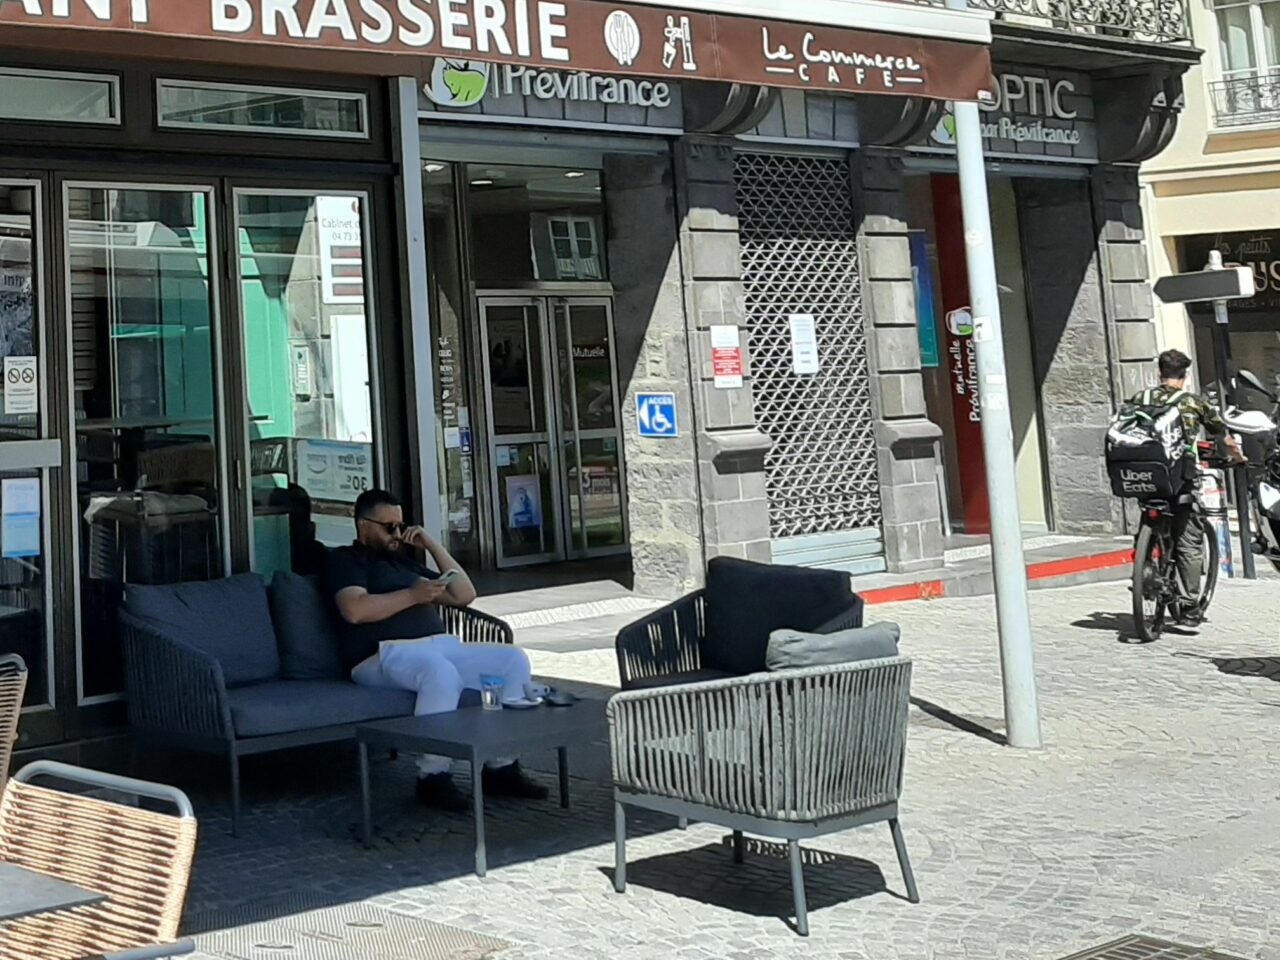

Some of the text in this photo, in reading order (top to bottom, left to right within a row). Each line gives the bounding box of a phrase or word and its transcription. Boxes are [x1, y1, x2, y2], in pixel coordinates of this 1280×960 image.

[762, 26, 921, 71] Le Commerce
[798, 64, 894, 88] CAFE
[1120, 469, 1153, 481] Uber
[1122, 482, 1158, 493] Eats
